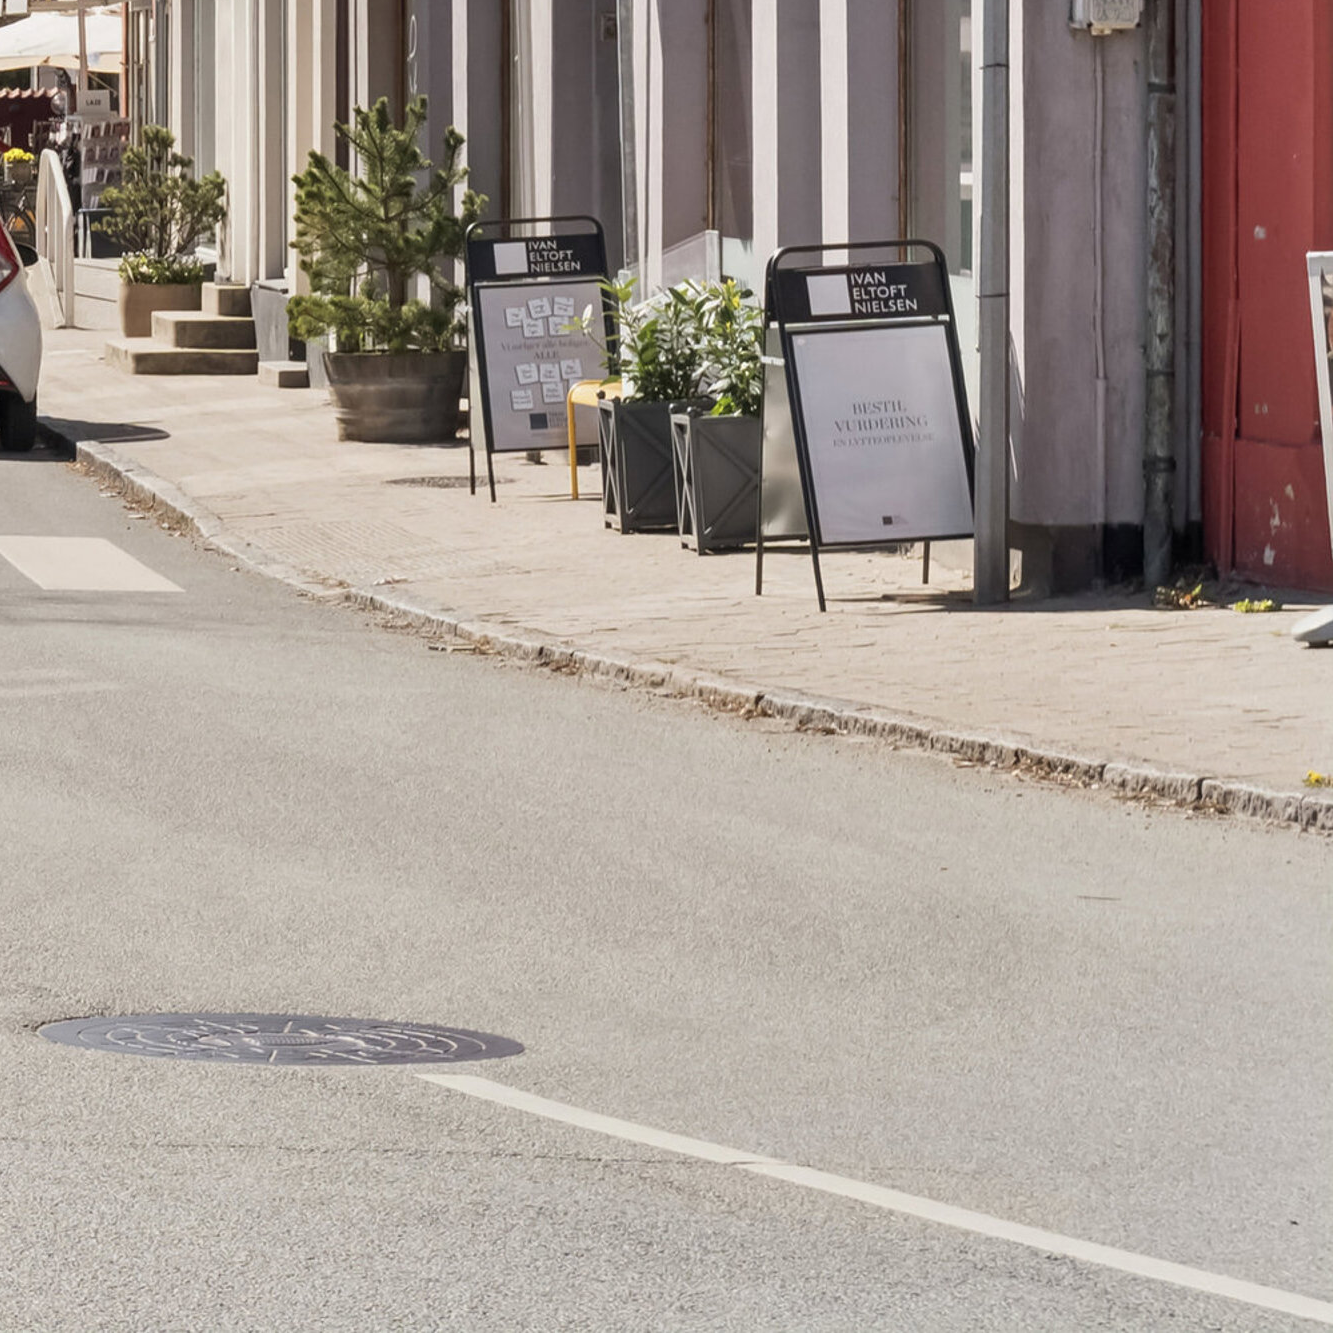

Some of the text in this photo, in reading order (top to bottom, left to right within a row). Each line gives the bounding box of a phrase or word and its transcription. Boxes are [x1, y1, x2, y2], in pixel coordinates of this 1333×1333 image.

[528, 240, 557, 251] IVAN
[529, 249, 574, 262] ELTOFT
[530, 261, 581, 274] NIELSEN
[850, 272, 887, 285] IVAN
[853, 284, 907, 300] ELTOFT
[854, 298, 918, 314] NIELSEN
